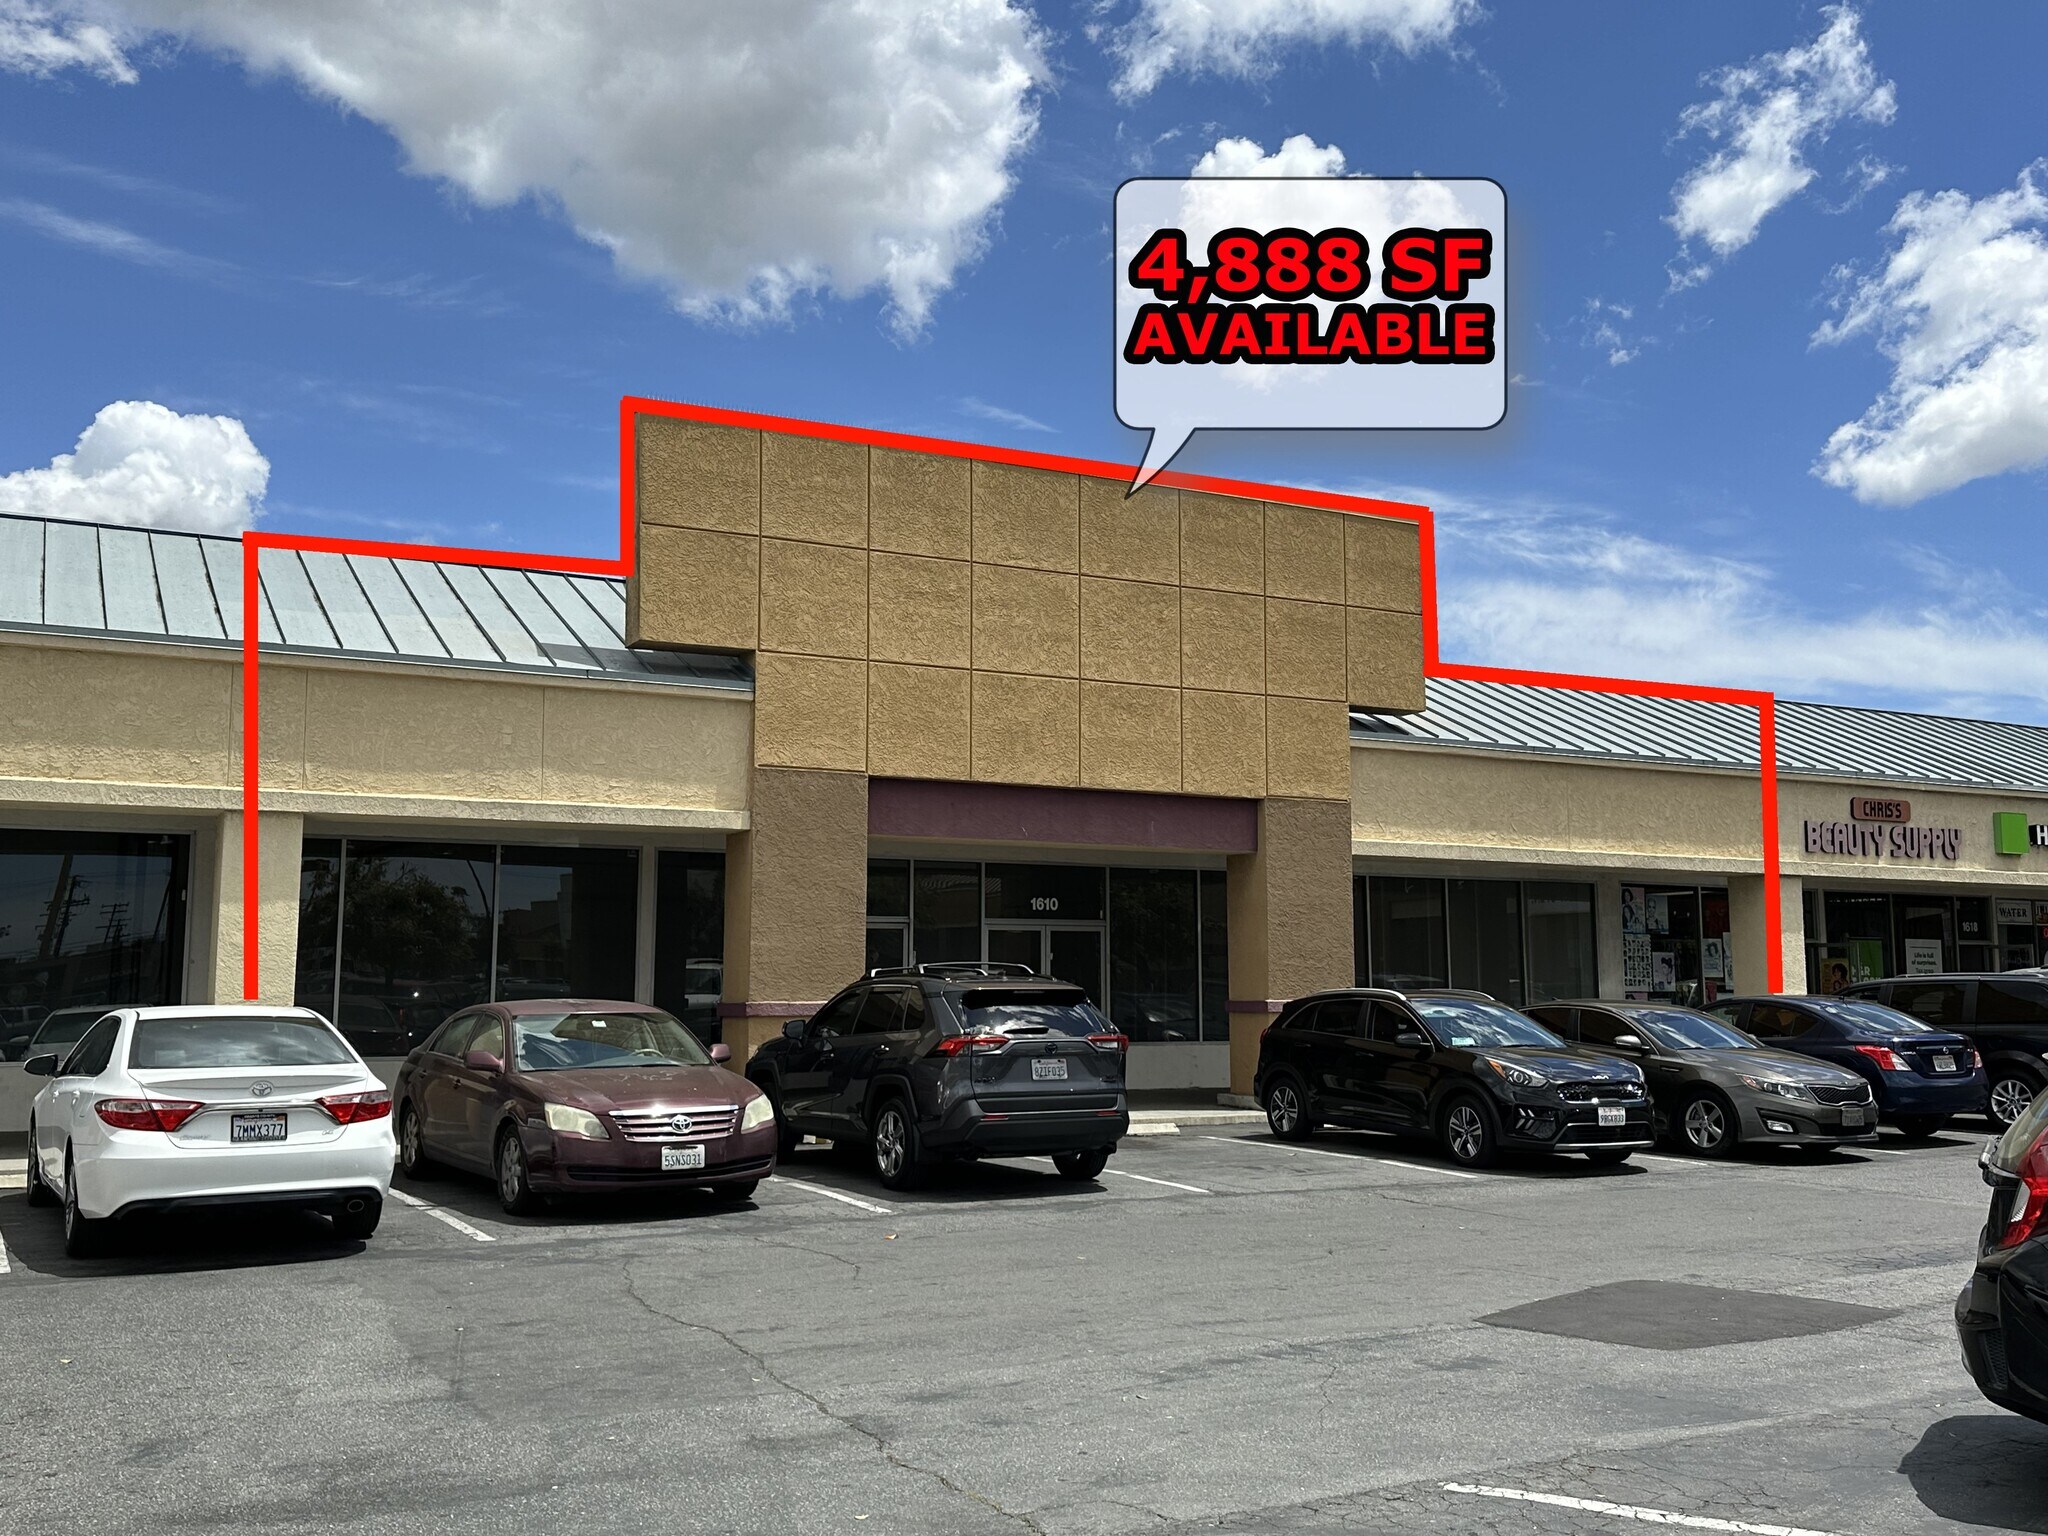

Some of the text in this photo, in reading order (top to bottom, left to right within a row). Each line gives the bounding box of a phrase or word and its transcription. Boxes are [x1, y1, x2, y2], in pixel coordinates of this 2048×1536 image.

[1863, 801, 1902, 819] CHRIS'S
[1804, 820, 1962, 860] BEAUTY SUPPLY
[1030, 897, 1059, 911] 1610
[1999, 907, 2027, 918] WATER
[1962, 922, 1978, 932] 1618
[235, 1124, 283, 1139] 7MMX377
